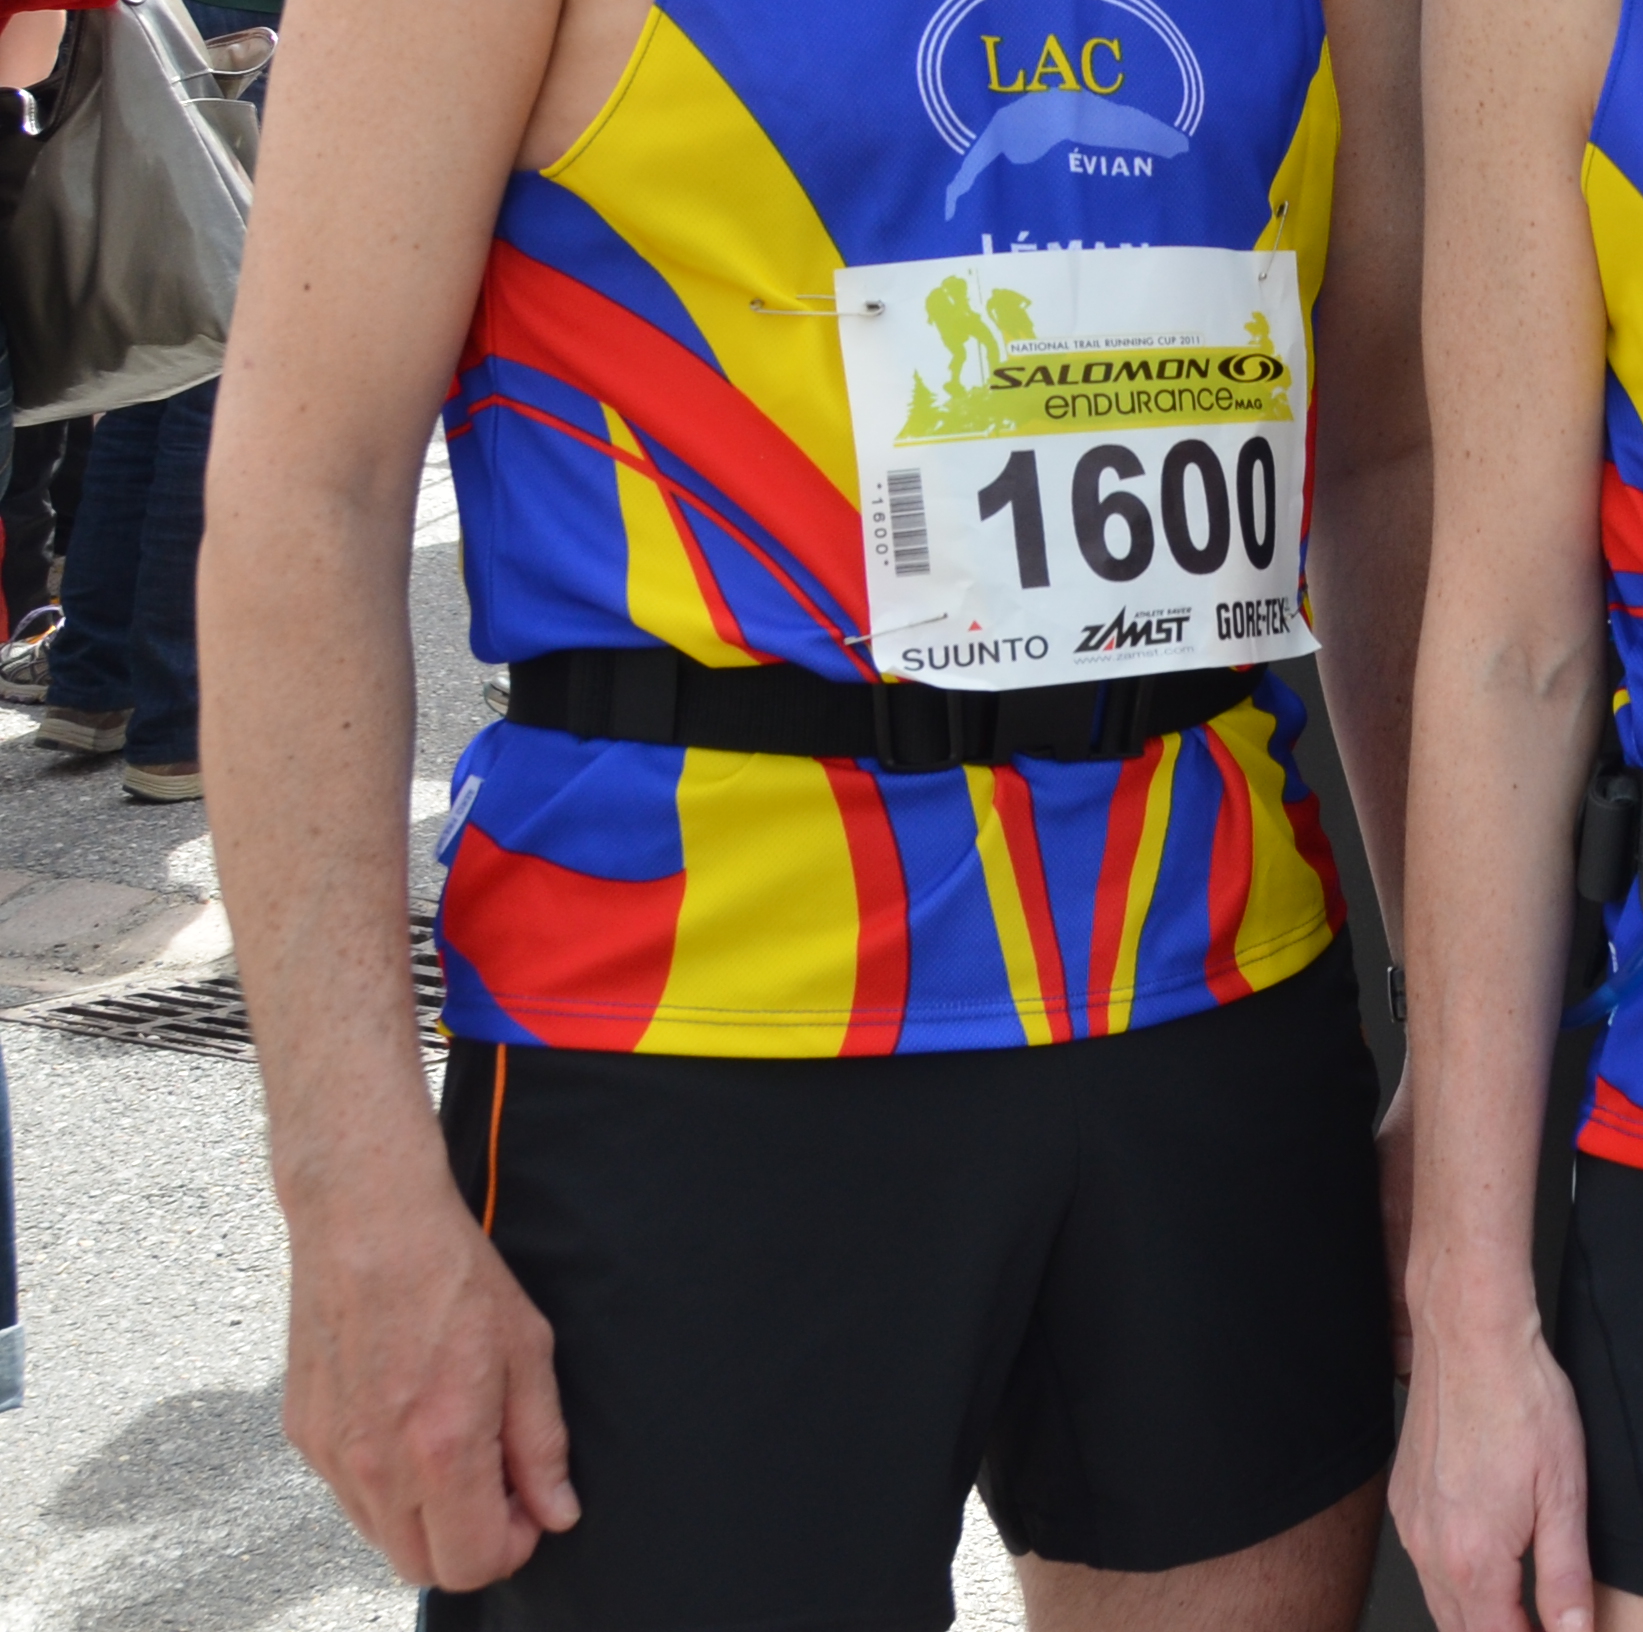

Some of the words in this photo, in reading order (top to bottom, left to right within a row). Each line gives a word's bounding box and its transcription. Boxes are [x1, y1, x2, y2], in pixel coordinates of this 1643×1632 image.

[980, 34, 1124, 95] LAC
[1069, 148, 1153, 177] ÉVIAN
[1010, 341, 1069, 353] NATIONAL
[1074, 339, 1100, 350] TRAIL
[1105, 336, 1153, 347] RUNNING
[1158, 335, 1176, 345] CUP
[1180, 335, 1200, 345] 2011
[990, 358, 1210, 390] SALOMON
[977, 436, 1276, 590] 1600
[1216, 598, 1290, 640] GORE-TEX
[902, 635, 1049, 672] SUUNTO
[1074, 646, 1195, 666] www.zamst.com
